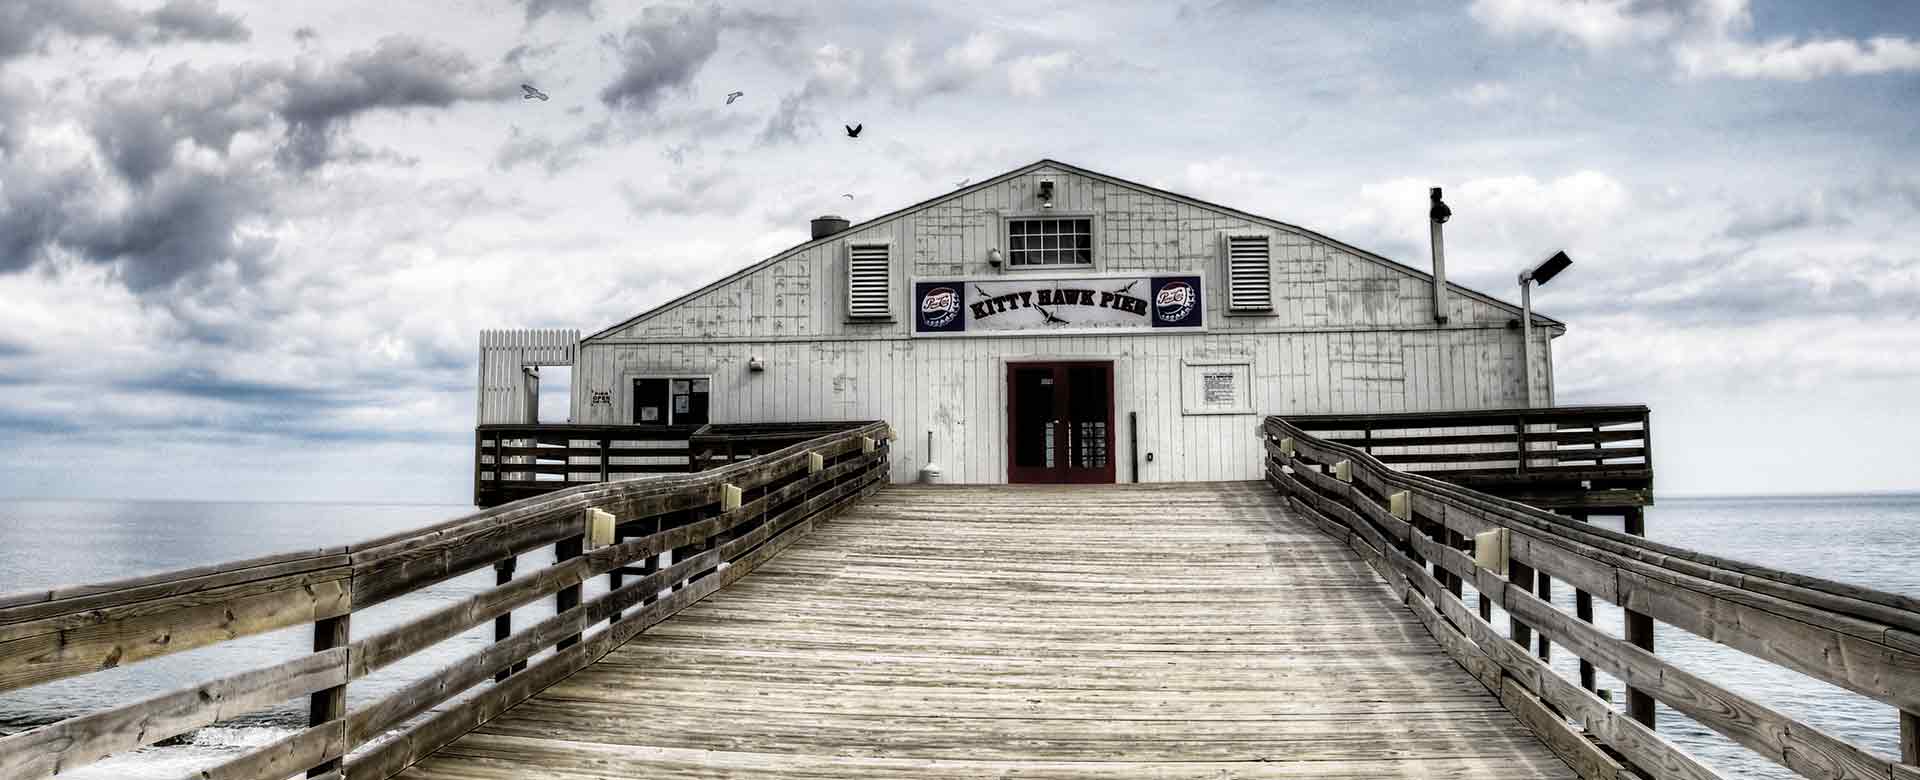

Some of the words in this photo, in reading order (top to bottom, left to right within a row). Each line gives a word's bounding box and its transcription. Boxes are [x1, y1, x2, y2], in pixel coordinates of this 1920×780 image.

[969, 291, 1032, 320] KITTY
[1037, 289, 1096, 306] HAWK
[1099, 291, 1148, 317] PIER
